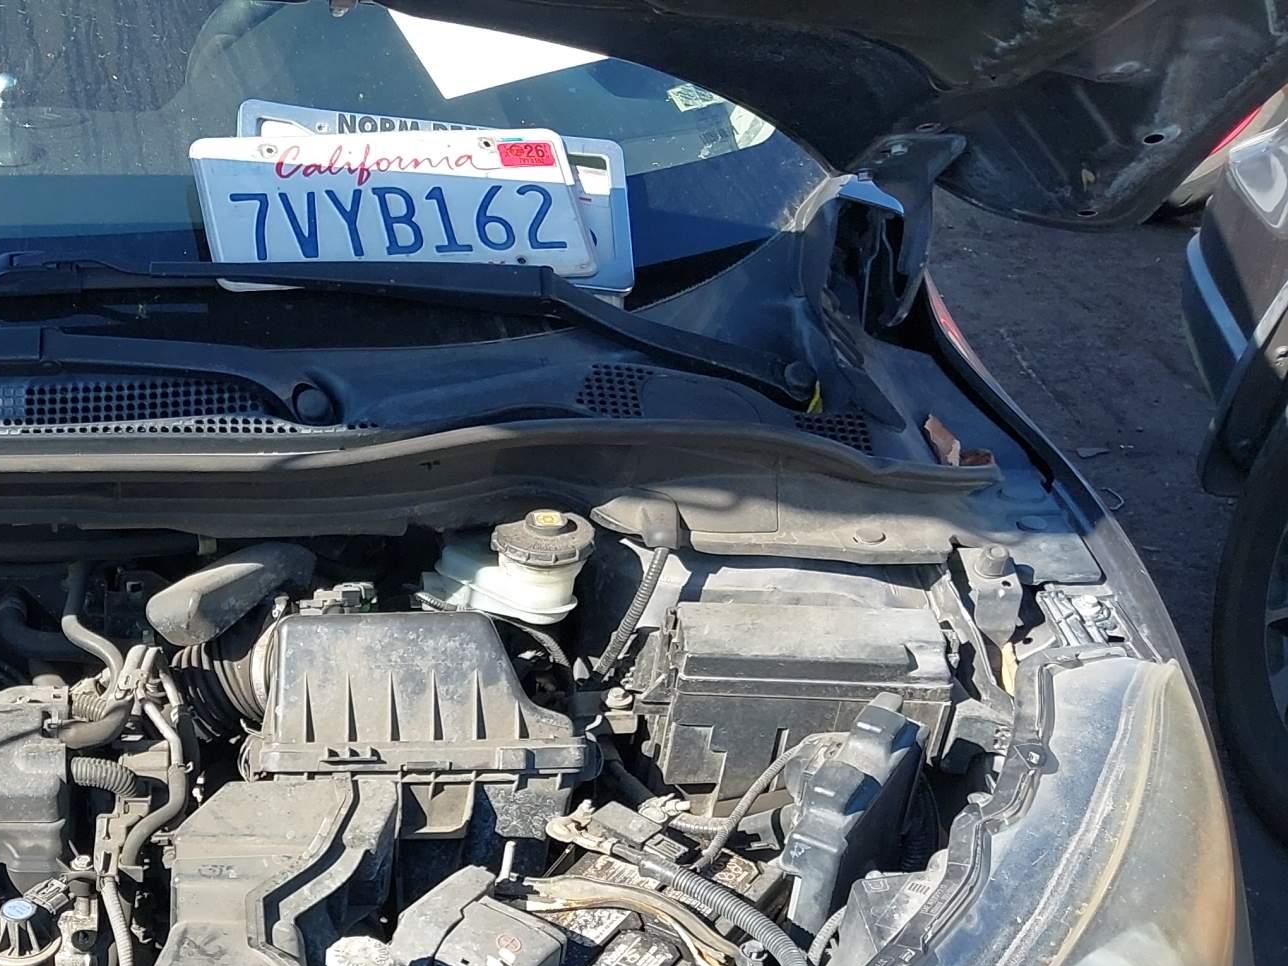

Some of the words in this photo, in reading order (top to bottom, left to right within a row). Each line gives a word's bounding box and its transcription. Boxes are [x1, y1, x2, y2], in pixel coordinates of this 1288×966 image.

[275, 144, 487, 185] California
[524, 144, 545, 158] 26
[229, 184, 568, 261] 7VYB162
